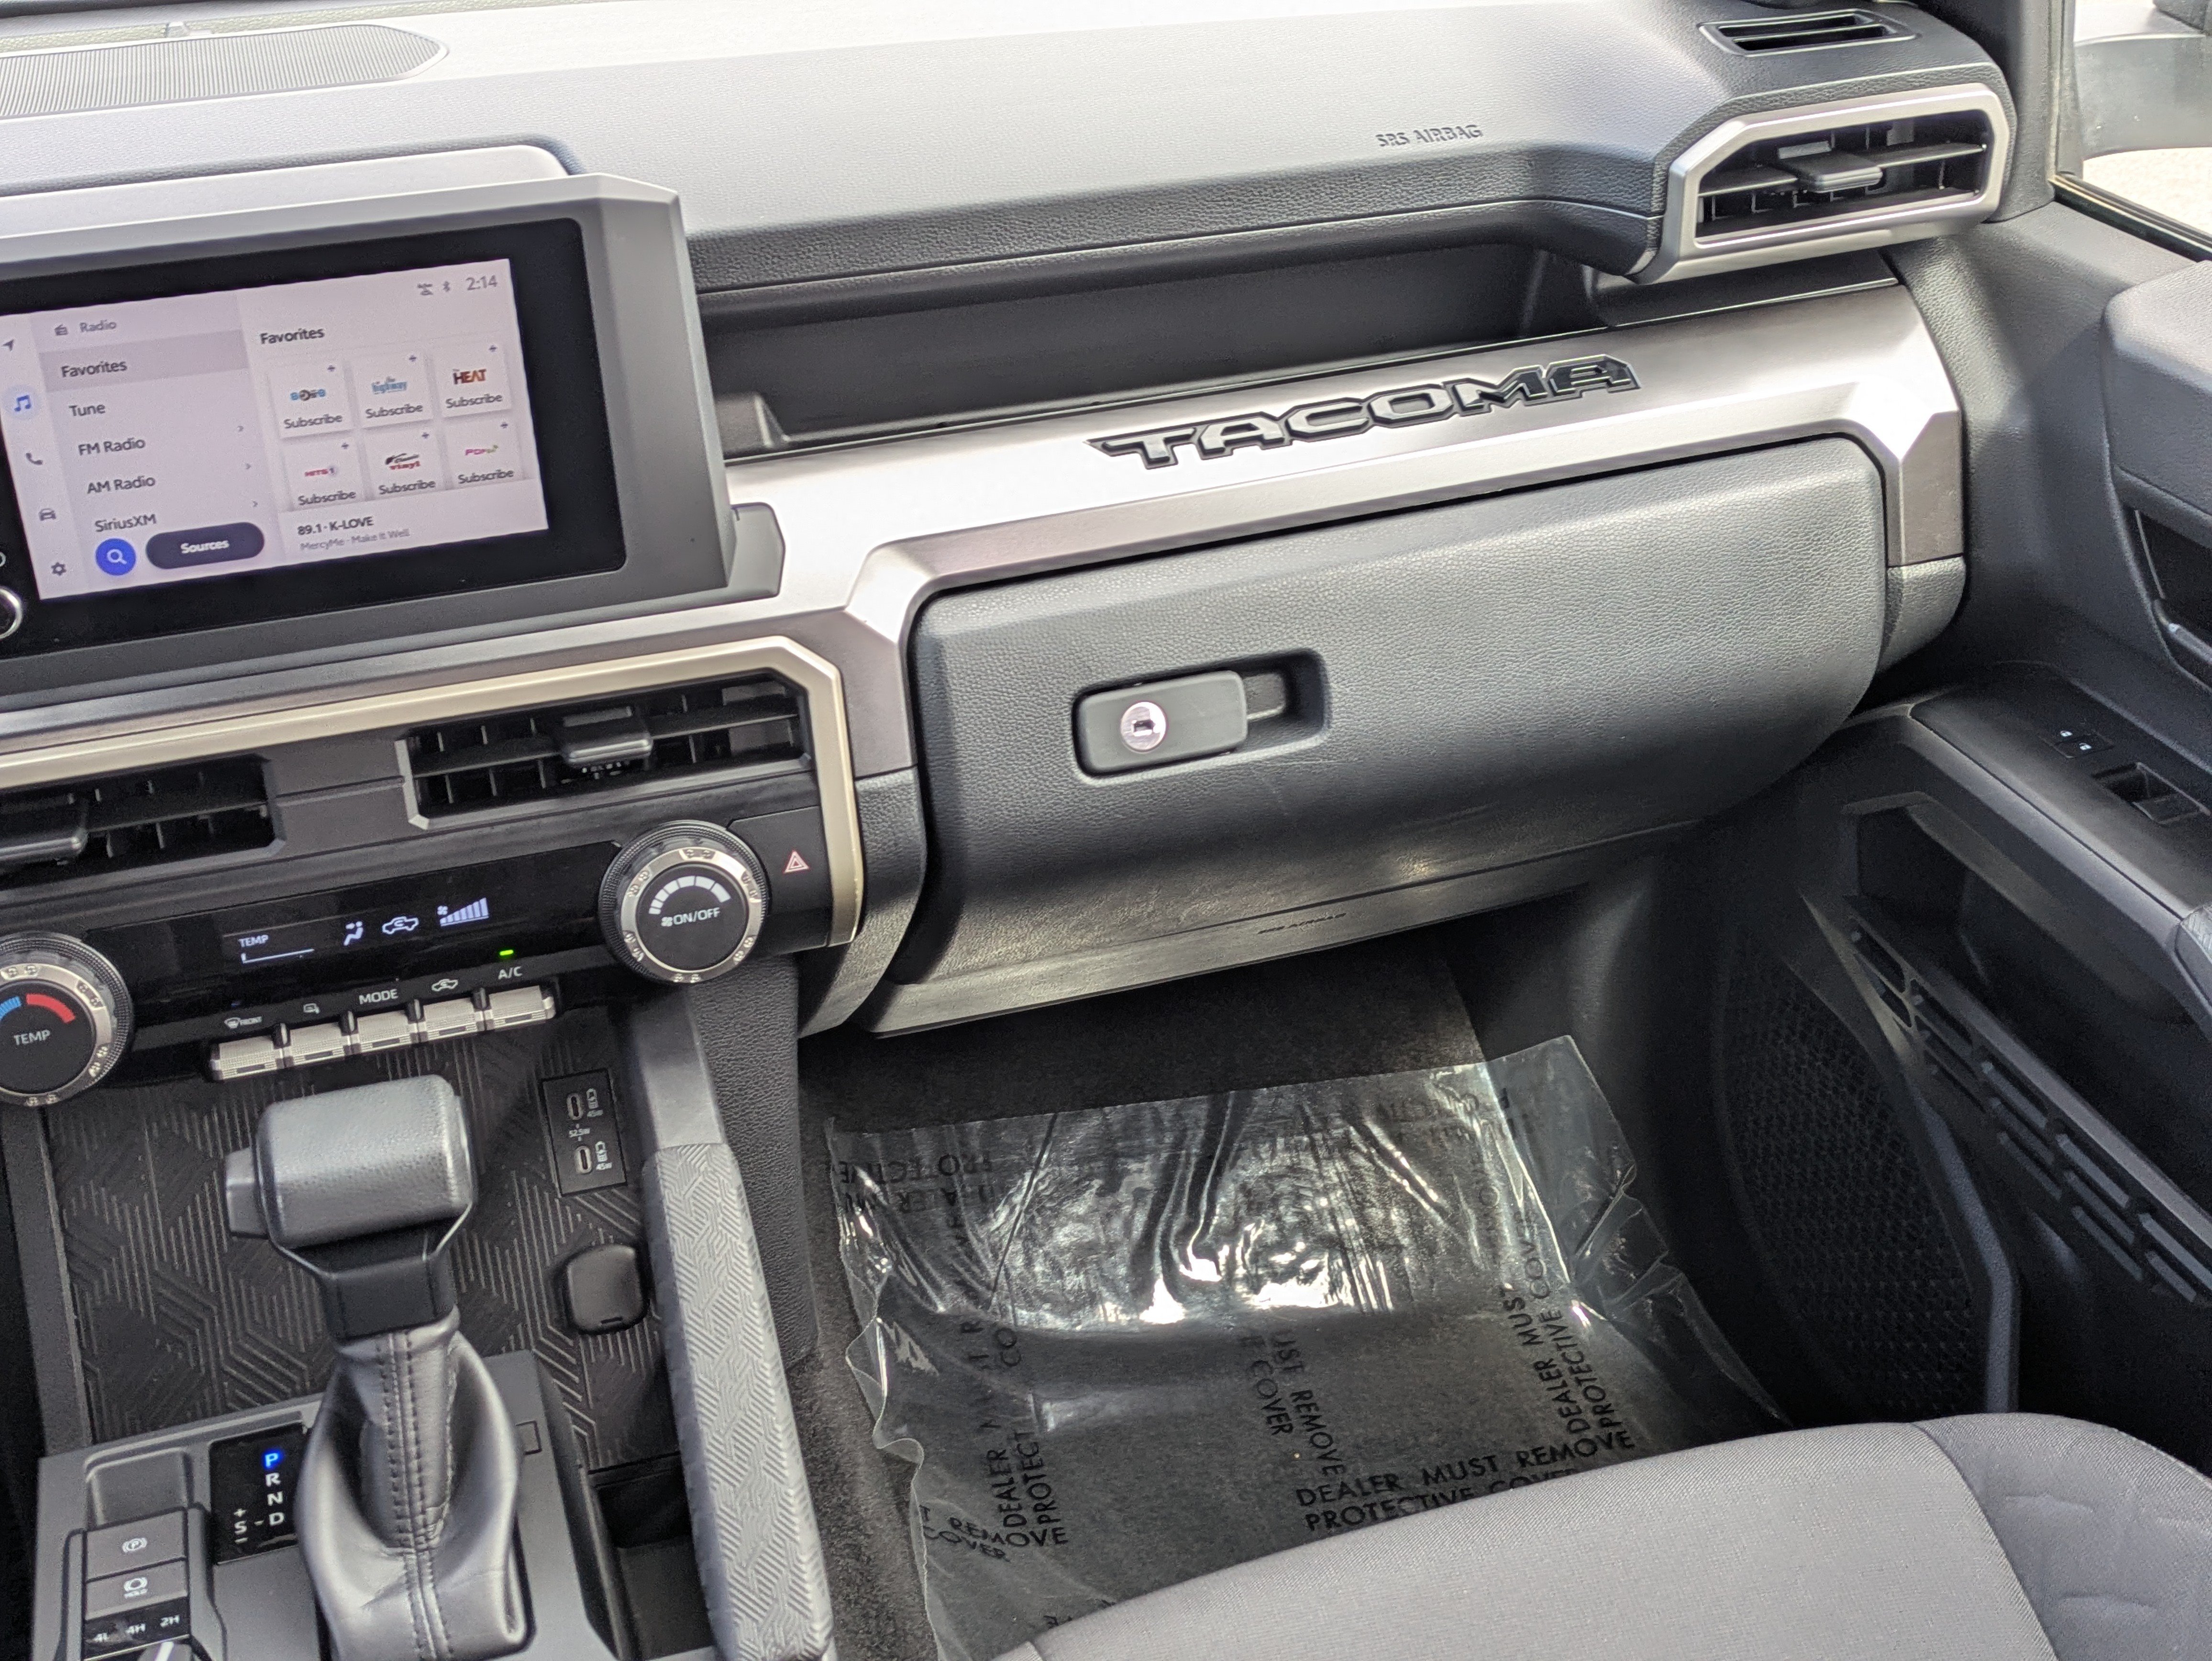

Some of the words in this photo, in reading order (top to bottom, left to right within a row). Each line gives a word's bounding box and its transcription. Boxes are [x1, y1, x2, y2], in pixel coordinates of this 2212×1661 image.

[1375, 132, 1410, 147] SRS
[1413, 124, 1483, 144] AIRBAG
[466, 275, 498, 291] 2:14
[79, 319, 117, 333] Radio
[260, 327, 325, 344] Favorites
[61, 361, 128, 377] Favorites
[453, 369, 487, 385] HEAT
[69, 402, 106, 417] Tune
[446, 393, 503, 409] Subscribe
[365, 404, 423, 419] Subscribe
[1084, 354, 1642, 470] TACOMA
[284, 414, 343, 429] Subscribe
[78, 441, 100, 456] FM
[104, 437, 146, 453] Radio
[458, 468, 514, 484] Subscribe
[87, 480, 111, 494] AM
[114, 476, 155, 491] Radio
[378, 479, 436, 496] Subscribe
[299, 489, 356, 506] Subscribe
[95, 514, 156, 532] SiriusXM
[297, 523, 322, 535] 89.1
[329, 516, 374, 531] K-LOVE
[180, 540, 229, 554] Sources
[673, 907, 720, 925] ON/OFF
[239, 934, 269, 948] TEMP
[498, 965, 523, 980] A/C
[359, 988, 398, 1005] MODE
[13, 1030, 51, 1046] TEMP
[1540, 1309, 1623, 1428] PROTECTIVE
[1250, 1360, 1294, 1436] COVER
[1533, 1357, 1591, 1434] DEALER
[1292, 1389, 1346, 1477] REMOVE
[265, 1452, 279, 1468] P
[1296, 1473, 1405, 1507] DEALER
[1422, 1455, 1497, 1487] MUST
[1515, 1428, 1635, 1468] REMOVE
[265, 1472, 281, 1487] R
[986, 1449, 1027, 1528] DEALER
[267, 1491, 283, 1506] N
[234, 1520, 247, 1535] S
[269, 1511, 285, 1526] D
[160, 1614, 180, 1628] 2H
